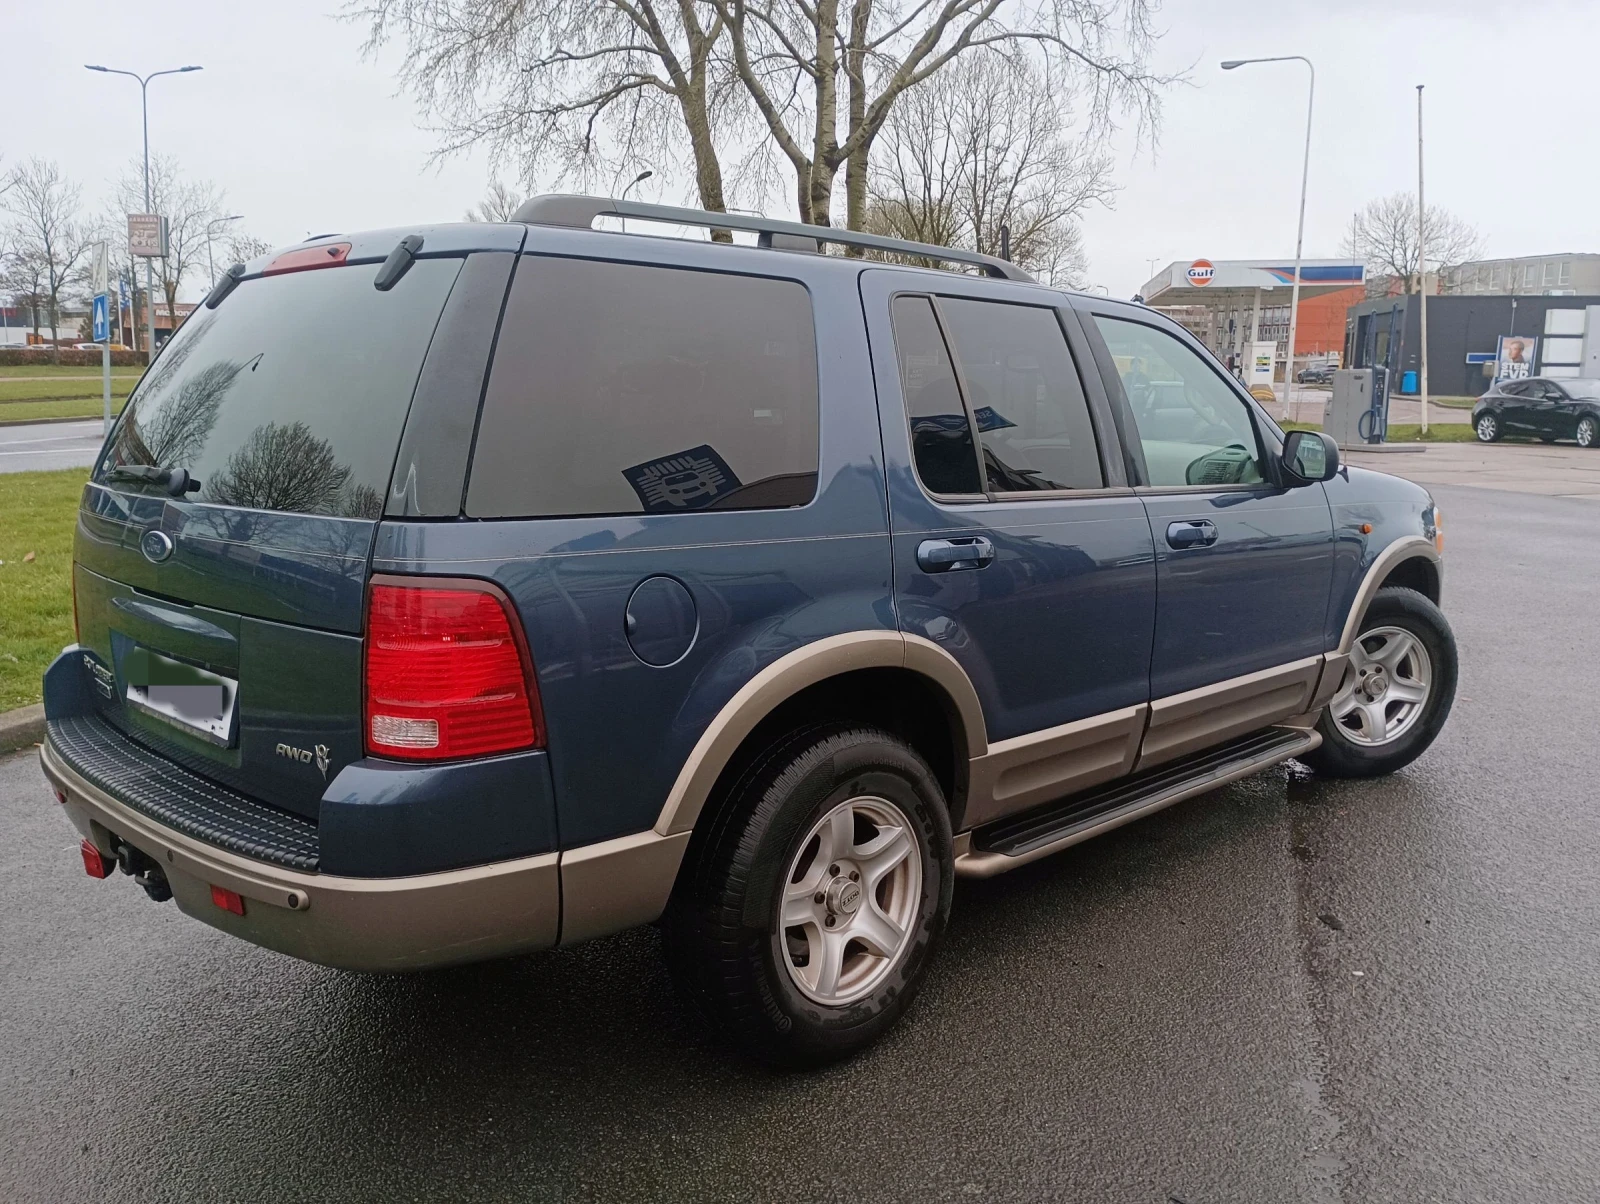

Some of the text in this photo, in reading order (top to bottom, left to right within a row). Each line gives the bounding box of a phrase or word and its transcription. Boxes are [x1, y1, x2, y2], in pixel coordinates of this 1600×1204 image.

[1188, 268, 1214, 277] Gulf
[1501, 362, 1529, 371] STEM
[275, 743, 313, 764] AWD
